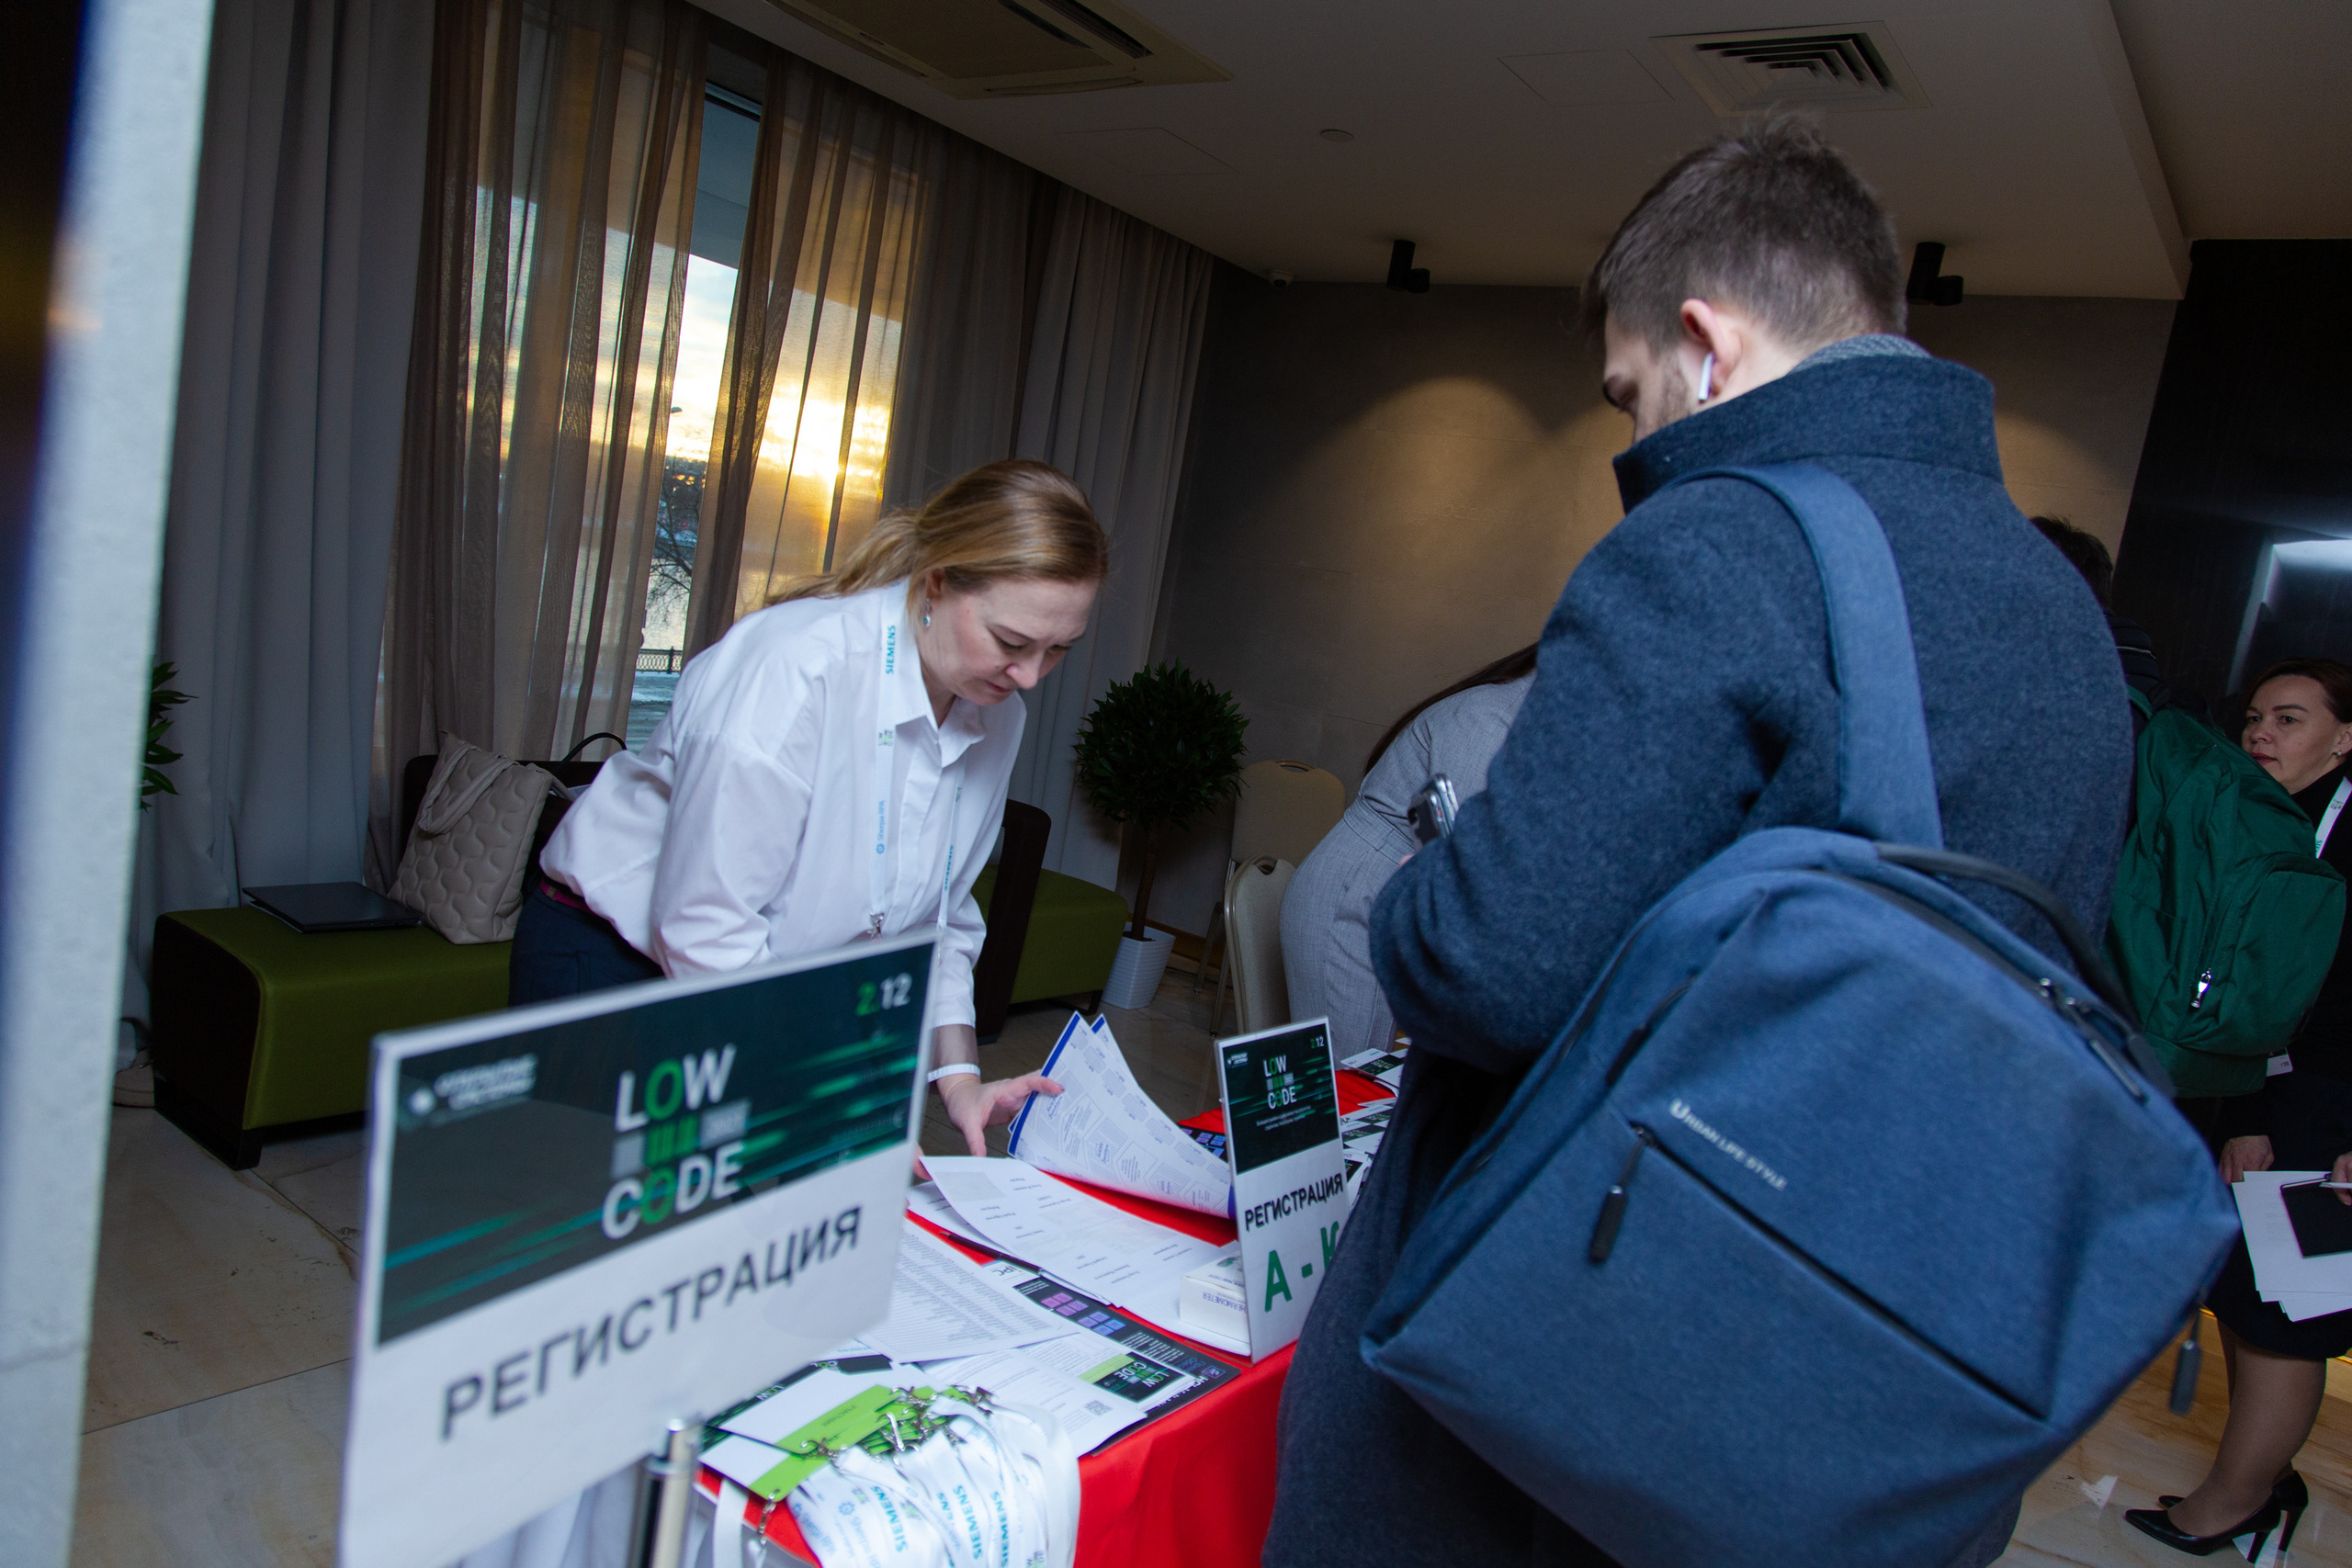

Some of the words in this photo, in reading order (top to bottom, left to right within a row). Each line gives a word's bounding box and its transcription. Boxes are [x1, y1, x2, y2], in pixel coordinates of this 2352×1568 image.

[884, 625, 897, 675] SIEMENS
[615, 1043, 738, 1133] LOW
[1263, 1054, 1287, 1077] LOW
[1267, 1087, 1297, 1110] CODE
[601, 1140, 744, 1241] CODE
[1244, 1173, 1343, 1232] РЕГИСТРАЦИЯ
[439, 1205, 865, 1444] РЕГИСТРАЦИЯ
[1202, 1292, 1248, 1314] HERMOMETER
[1114, 1361, 1147, 1381] CODE
[1141, 1371, 1170, 1388] LOW
[871, 1485, 910, 1553] SIEMENS
[953, 1484, 983, 1561] SIEMENS
[990, 1490, 1010, 1568] SIEMENS
